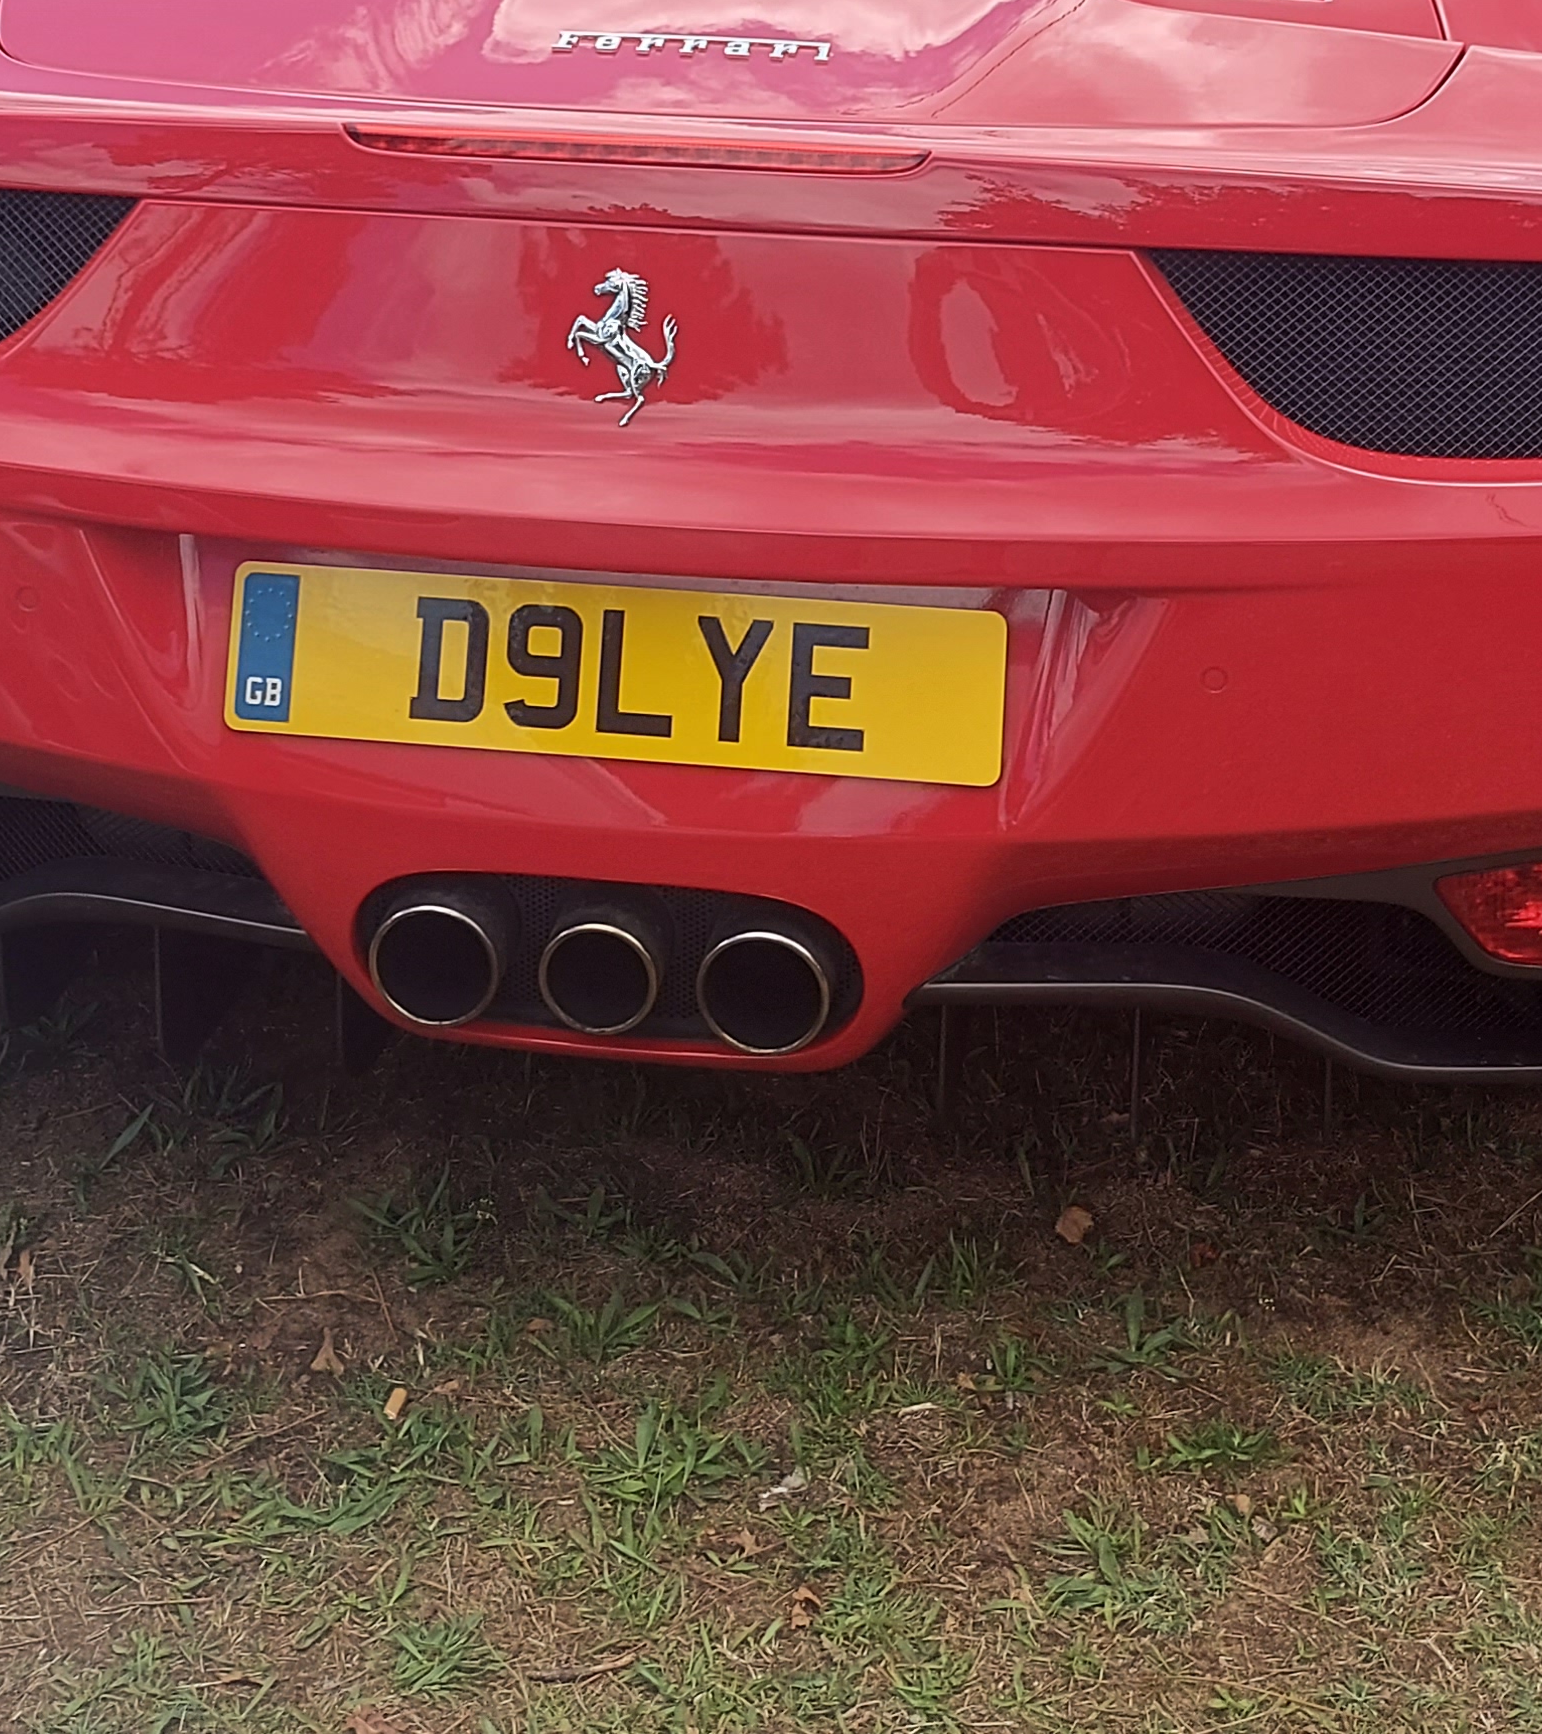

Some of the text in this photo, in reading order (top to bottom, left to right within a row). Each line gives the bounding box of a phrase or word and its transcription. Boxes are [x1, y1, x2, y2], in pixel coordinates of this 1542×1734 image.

[552, 30, 831, 62] Ferrari
[408, 594, 870, 753] D9LYE
[244, 675, 283, 707] GB
